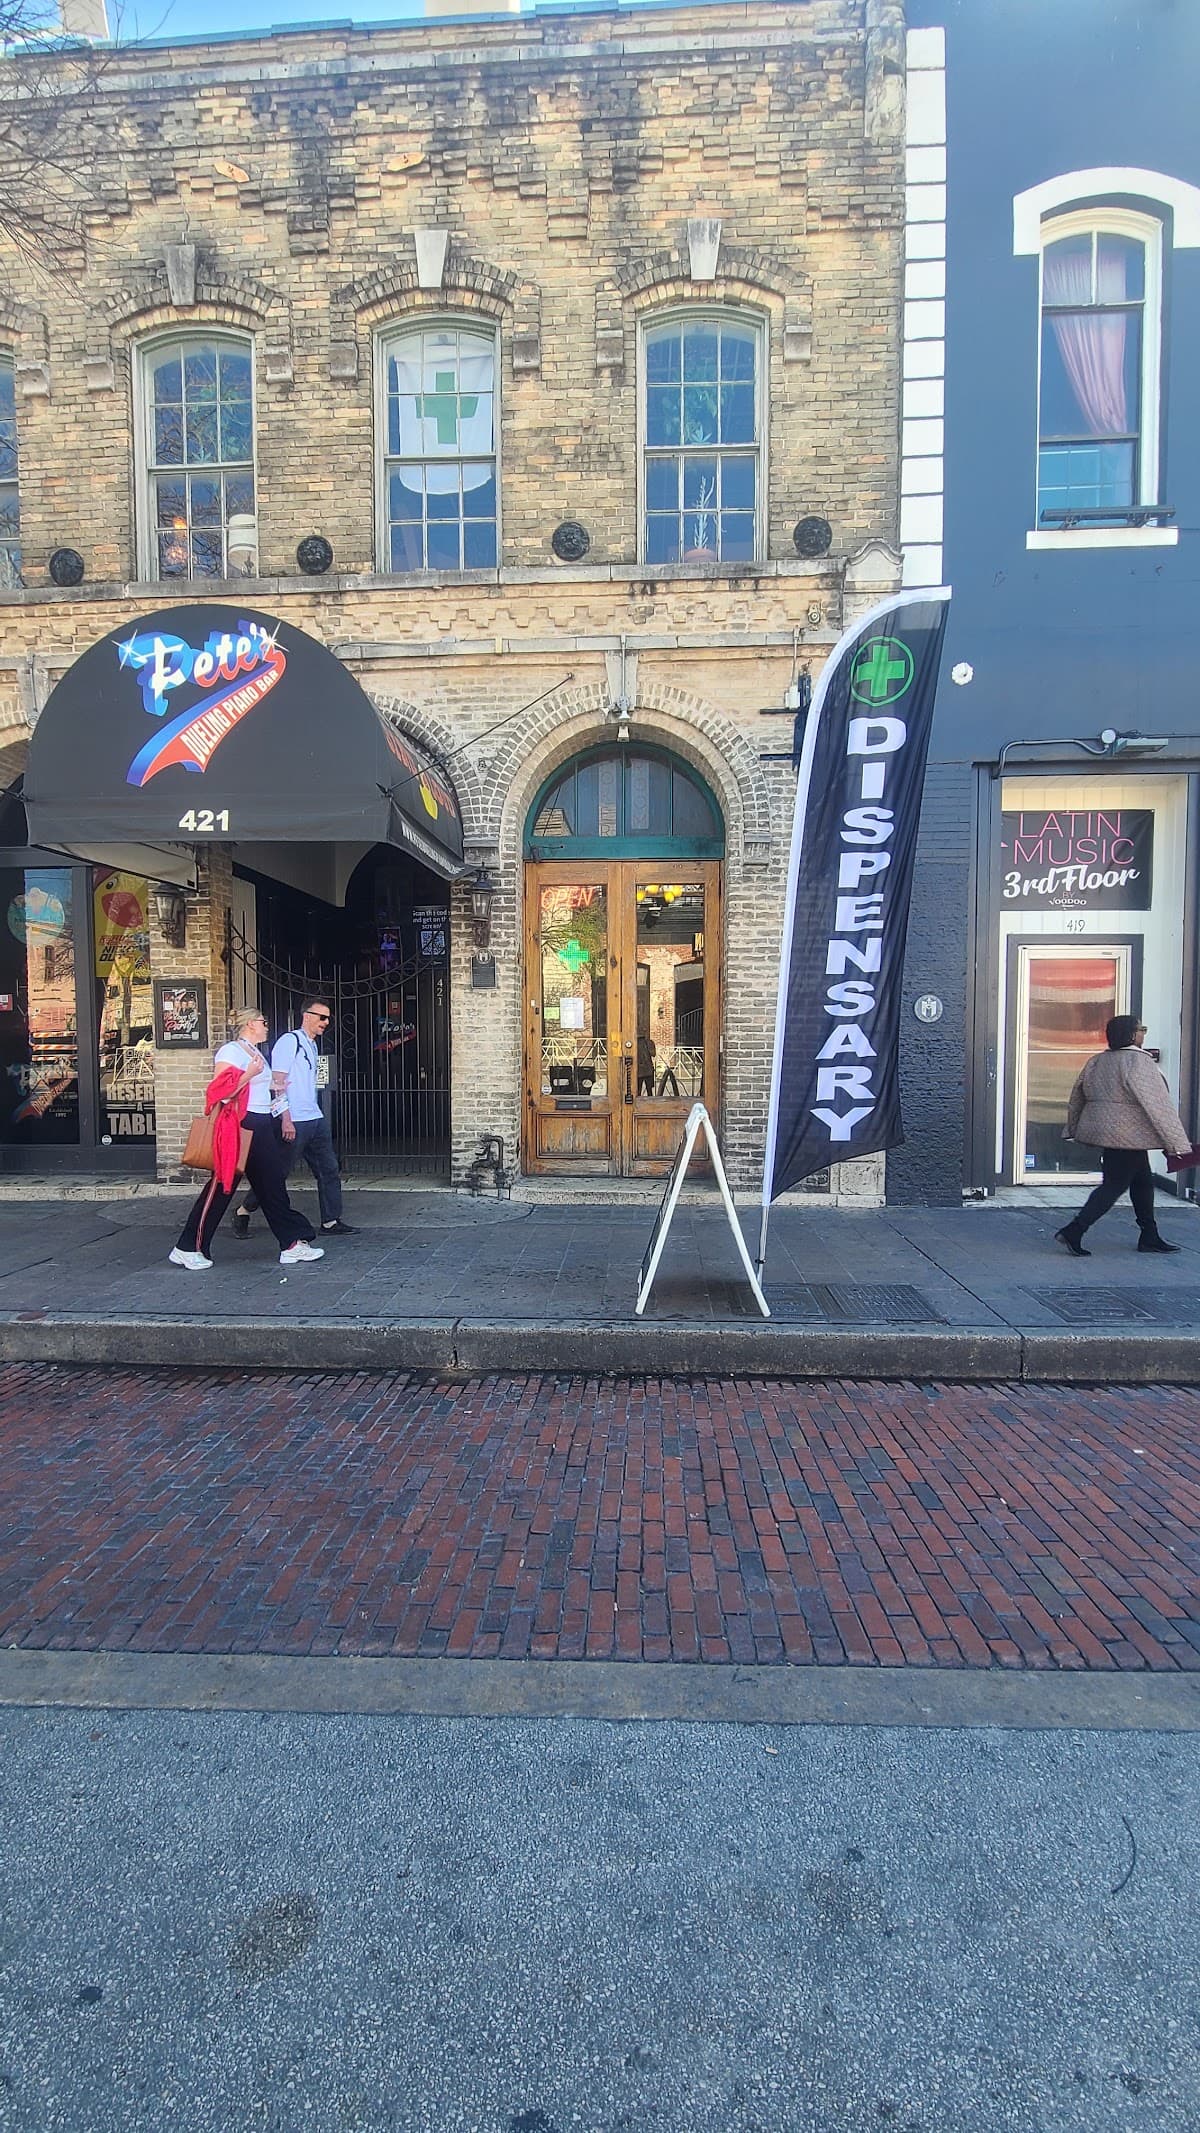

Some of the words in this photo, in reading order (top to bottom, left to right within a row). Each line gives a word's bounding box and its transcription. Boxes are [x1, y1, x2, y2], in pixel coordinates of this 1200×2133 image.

[180, 708, 231, 764] DUELING
[221, 687, 259, 720] PIANO
[255, 669, 279, 693] BAR
[178, 809, 229, 832] 421
[1019, 812, 1121, 838] LATIN
[1014, 838, 1135, 865] MUSIC
[541, 886, 595, 910] OPEN
[809, 716, 907, 1142] DISPENSARY
[1066, 919, 1086, 933] 419
[136, 1102, 143, 1111] A
